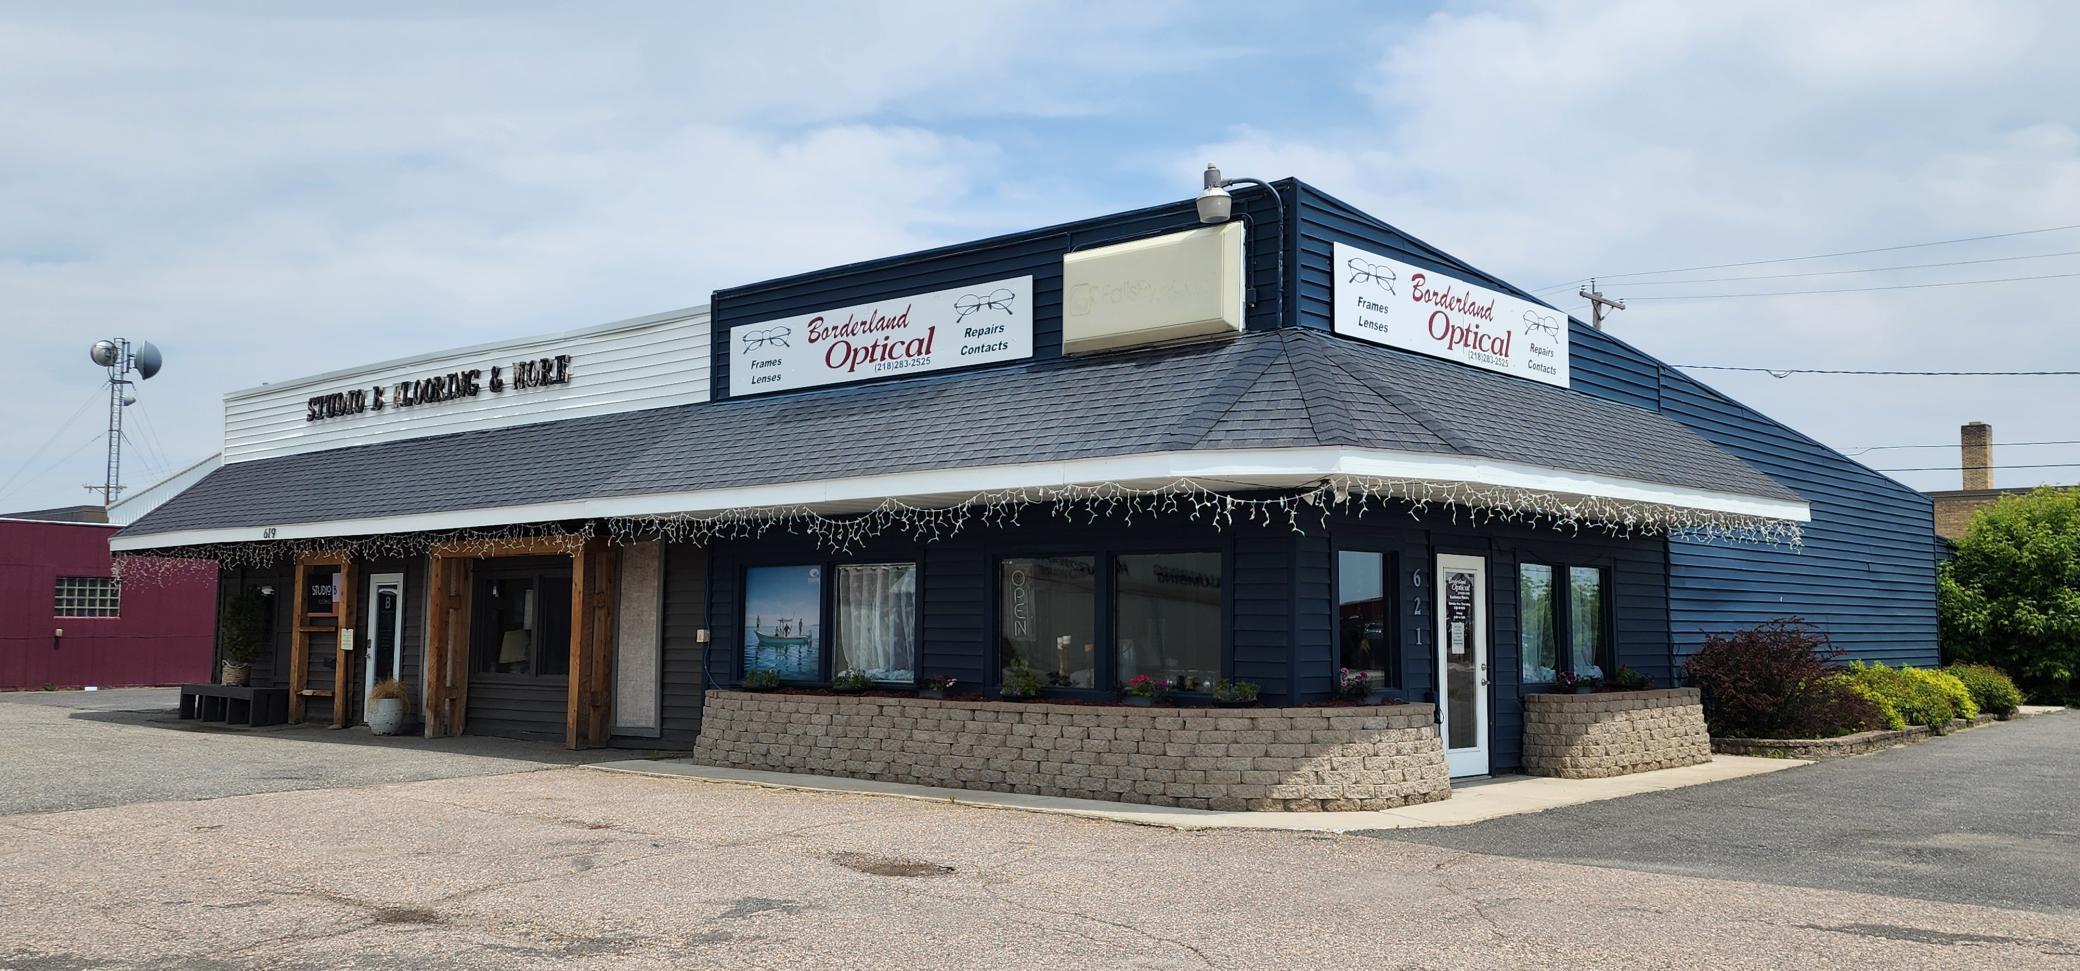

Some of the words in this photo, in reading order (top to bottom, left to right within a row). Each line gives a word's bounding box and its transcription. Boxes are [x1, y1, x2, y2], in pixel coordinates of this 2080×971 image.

[1357, 296, 1389, 314] Frames
[1411, 273, 1494, 322] Borderland
[808, 304, 912, 344] Borderland
[964, 323, 1005, 339] Repairs
[1358, 315, 1389, 333] Lenses
[1428, 310, 1512, 358] Optical
[825, 326, 936, 372] Optical
[960, 340, 1009, 356] Contacts
[1529, 342, 1554, 359] Repairs
[751, 356, 782, 370] Frames
[874, 357, 931, 373] (218)283-2525
[1467, 350, 1510, 368] (218)283-2525
[1527, 359, 1557, 376] Contacts
[751, 373, 782, 385] Lenses
[306, 388, 367, 422] STUDIO
[489, 366, 503, 393] &
[513, 354, 573, 390] MORE
[263, 527, 276, 539] 619
[311, 584, 332, 596] STUDIO
[1011, 570, 1027, 637] OPEN
